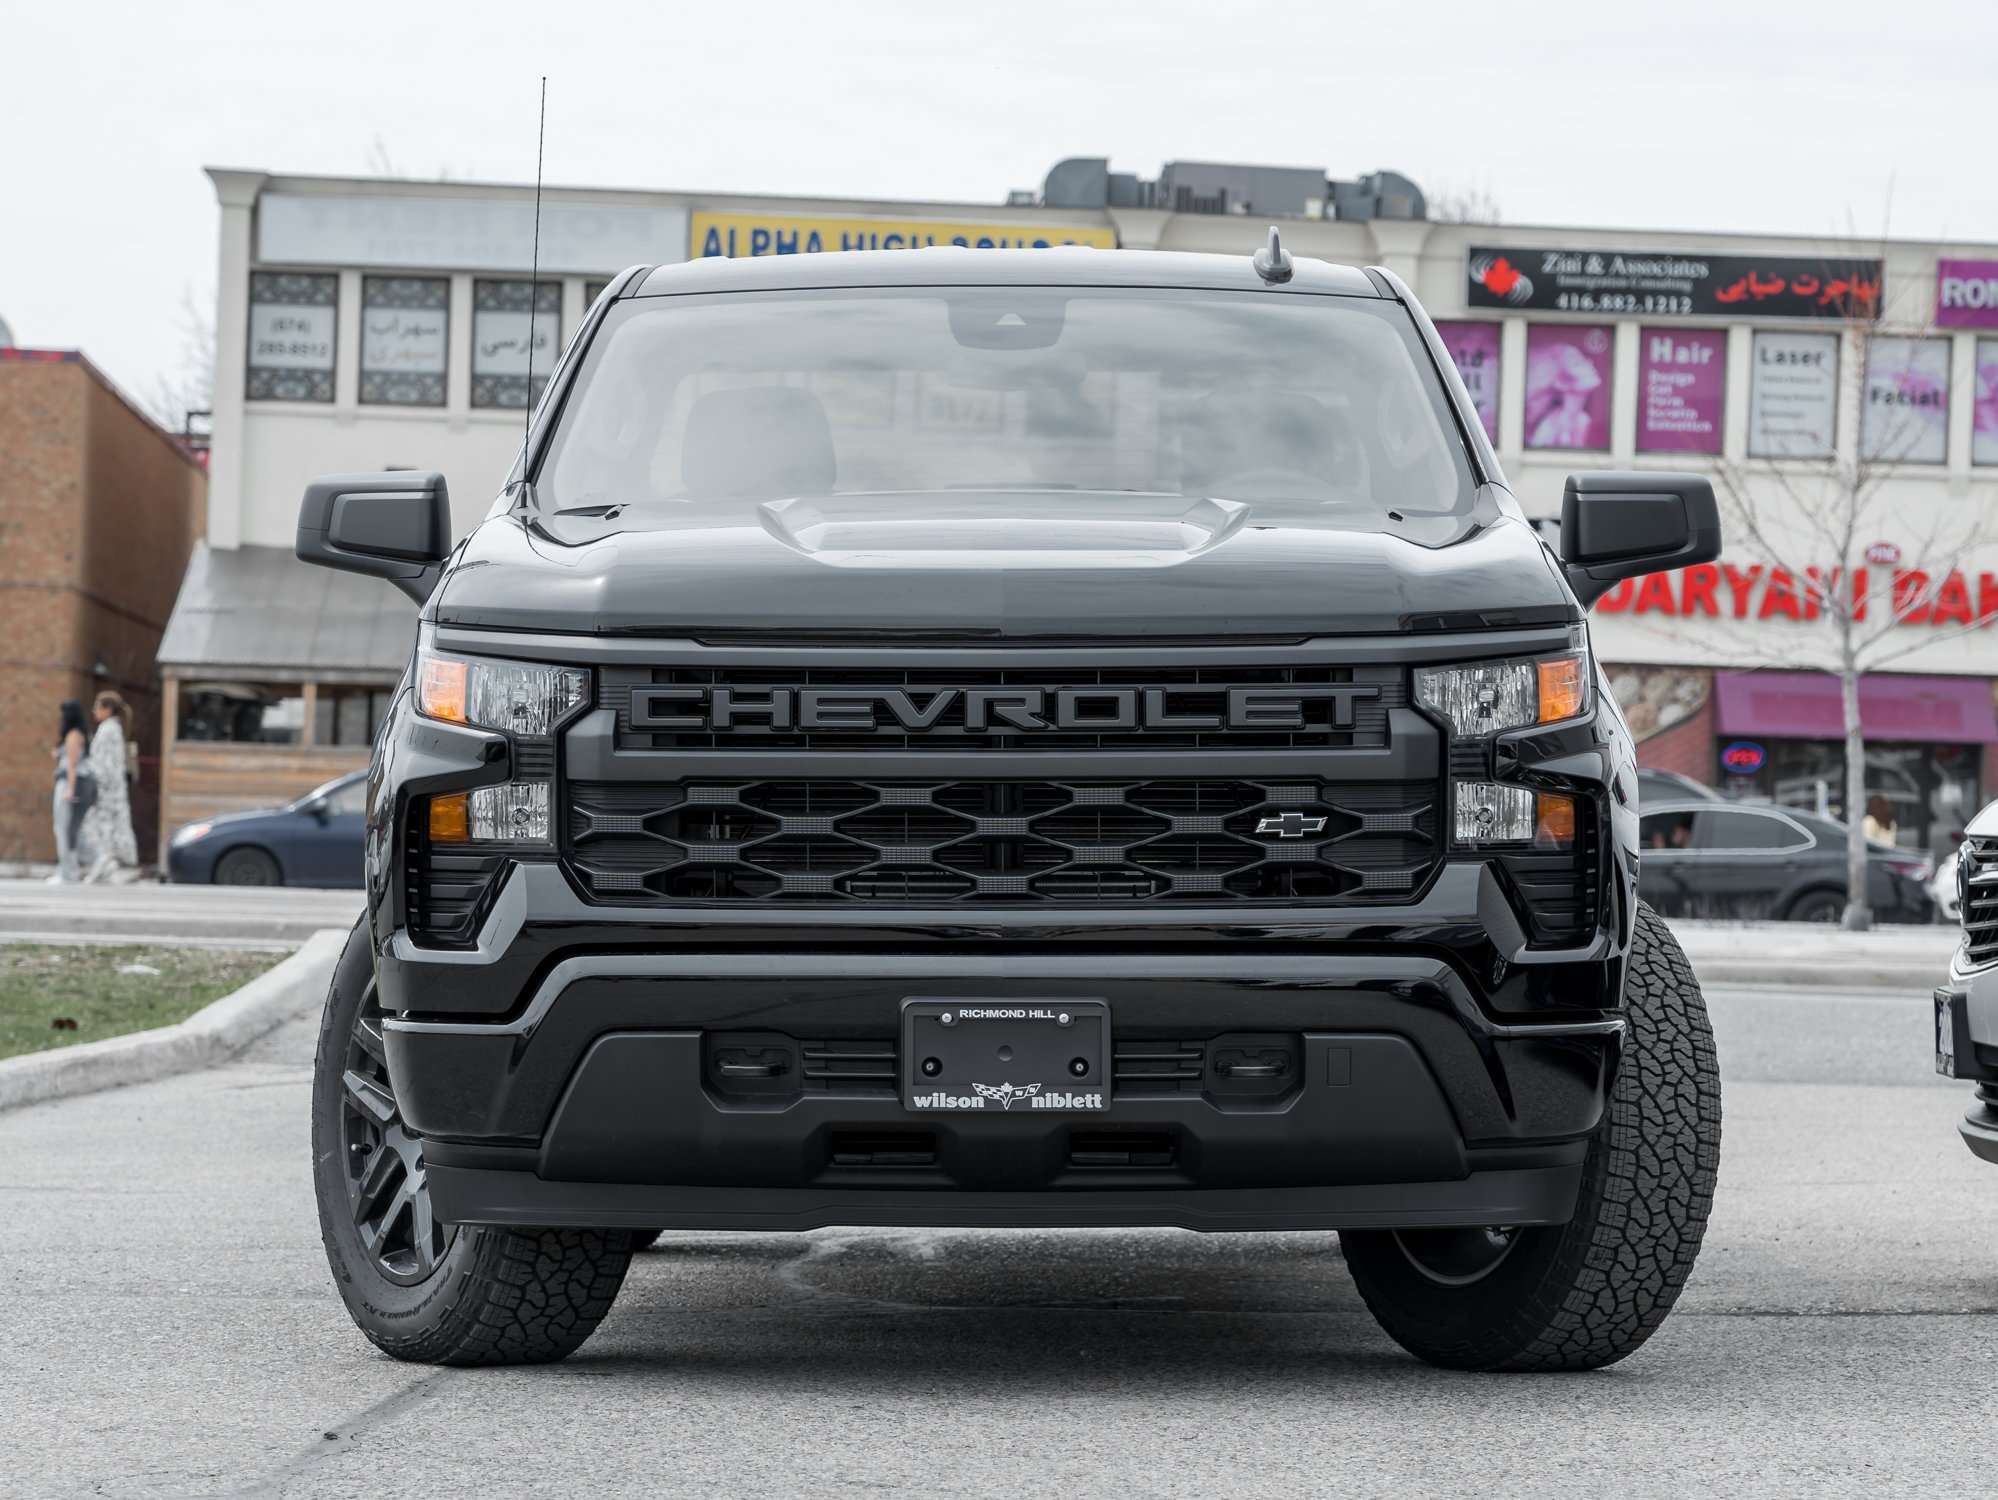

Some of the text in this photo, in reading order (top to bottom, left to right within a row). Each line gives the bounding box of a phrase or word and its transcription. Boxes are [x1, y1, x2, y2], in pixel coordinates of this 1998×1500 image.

[702, 226, 824, 258] ALPHA
[1584, 254, 1607, 275] &
[1610, 255, 1709, 279] Associates
[1650, 336, 1712, 366] Hair
[1760, 347, 1825, 367] Laser
[1870, 385, 1941, 407] Facial
[629, 685, 1383, 733] CHEVROLET
[959, 1009, 1056, 1018] RICHMOND HILL
[913, 1092, 1102, 1108] wilson niblett
